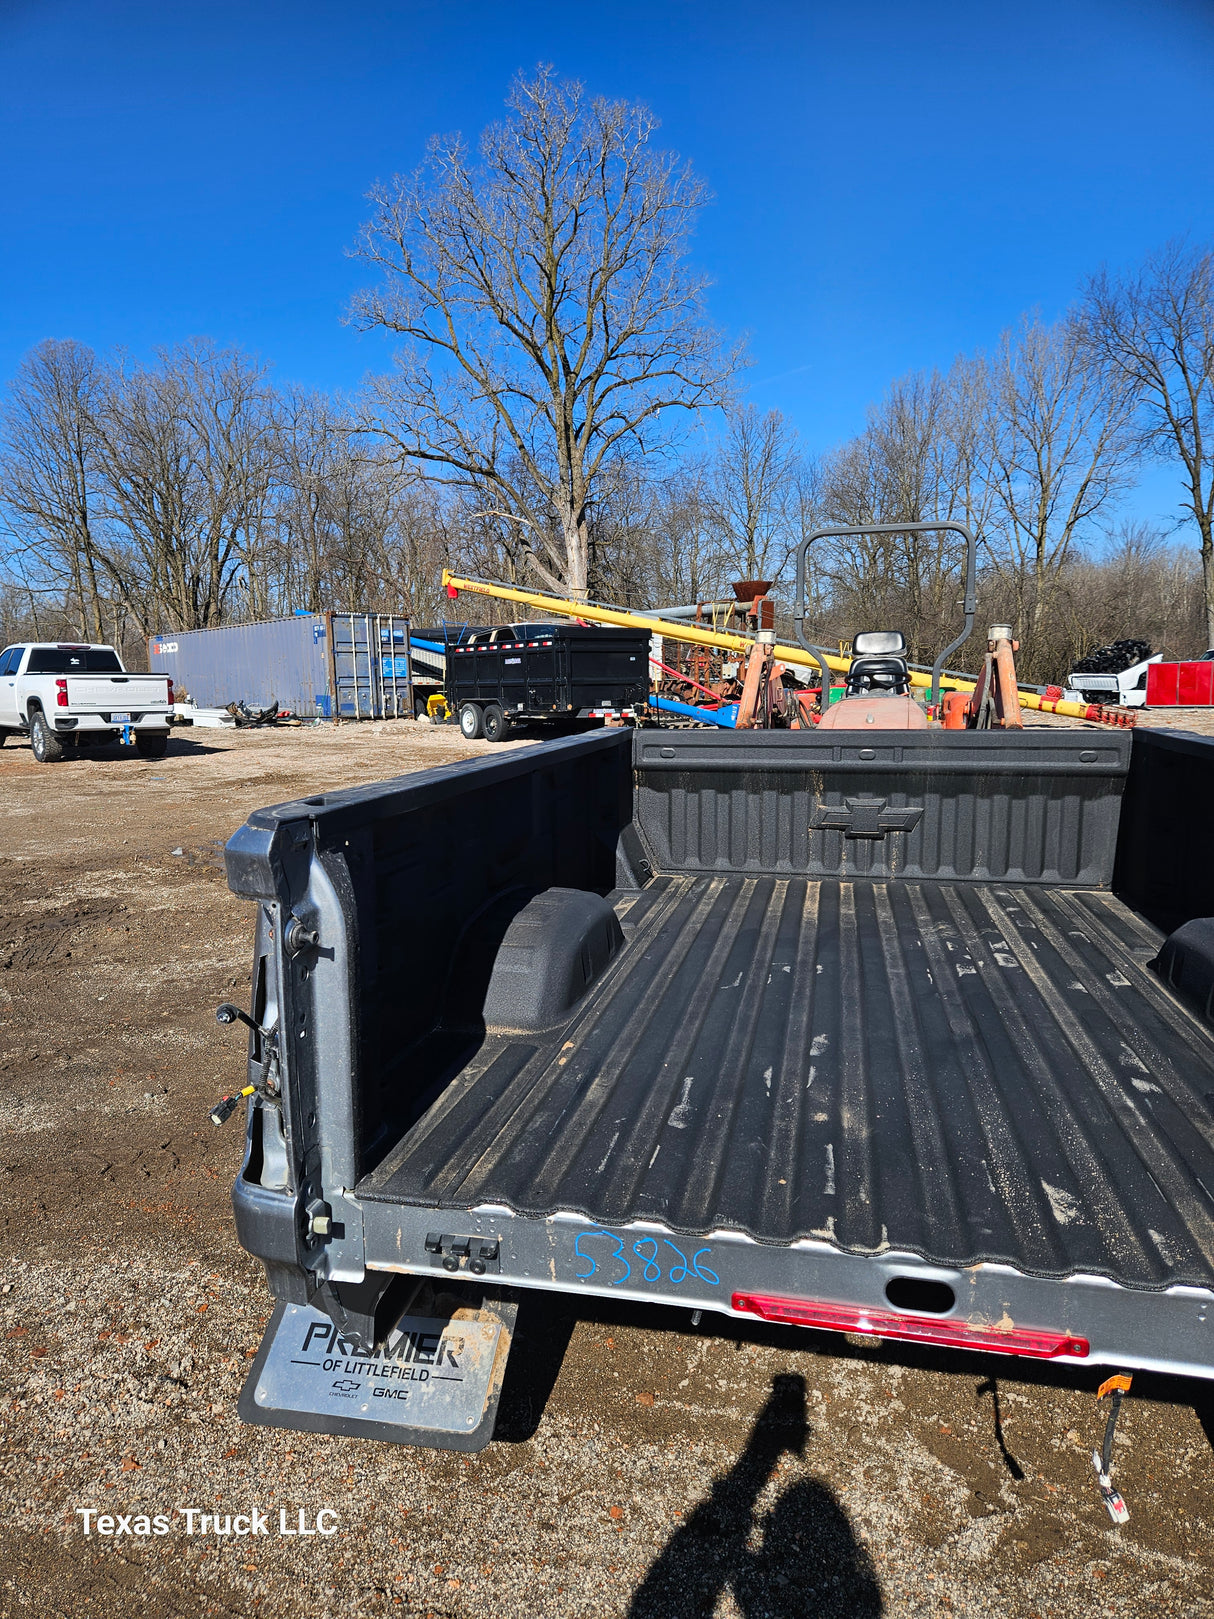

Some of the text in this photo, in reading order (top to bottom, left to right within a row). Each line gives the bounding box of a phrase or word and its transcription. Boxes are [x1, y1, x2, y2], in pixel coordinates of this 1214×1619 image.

[575, 1229, 720, 1285] 53826
[322, 1358, 430, 1382] OF LITTLEFIELD
[372, 1387, 409, 1400] GMC
